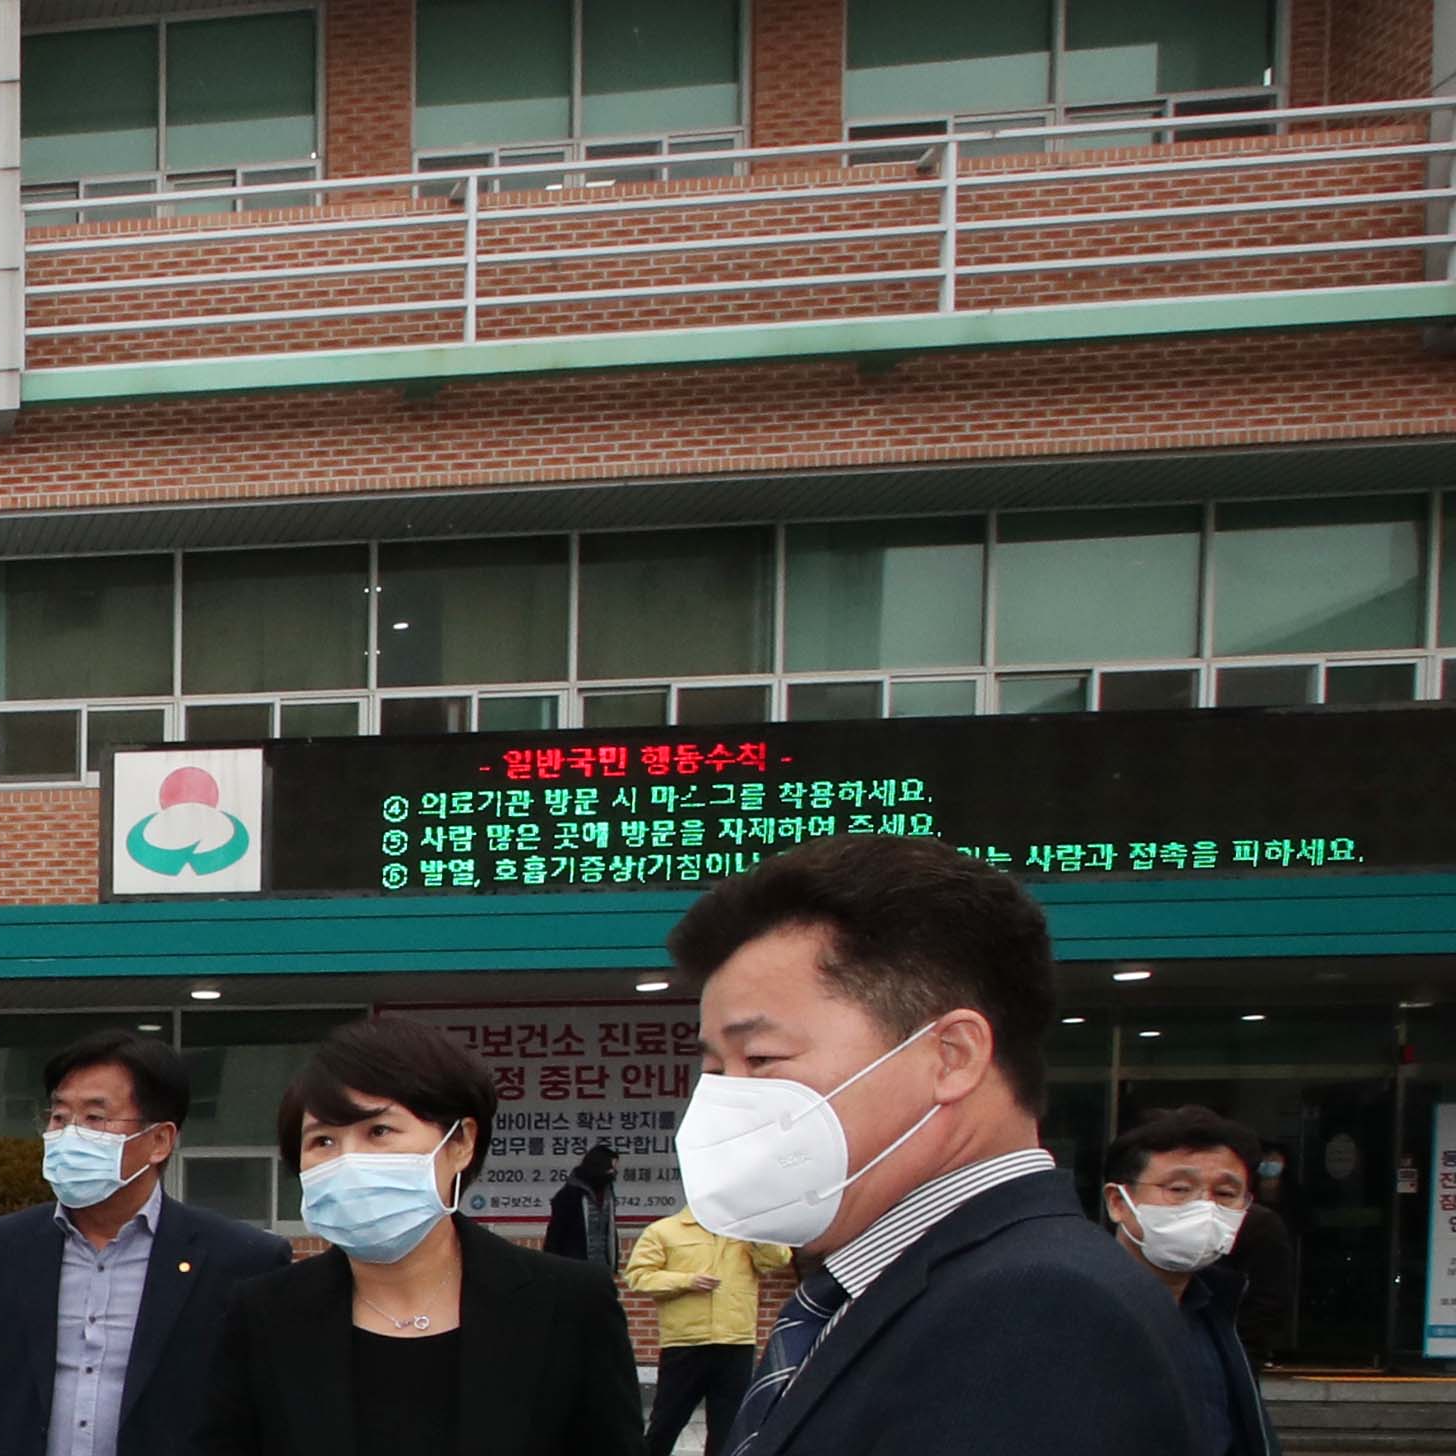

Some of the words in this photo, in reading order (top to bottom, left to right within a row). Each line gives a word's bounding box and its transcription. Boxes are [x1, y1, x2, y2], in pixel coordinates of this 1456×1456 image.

[502, 747, 629, 780] 일반국민
[640, 741, 769, 776] 행동수칙
[418, 789, 535, 820] 의료기관
[544, 787, 600, 817] 방문
[612, 786, 637, 814] 시
[419, 824, 478, 853] 사람
[486, 822, 542, 851] 많은
[553, 820, 610, 850] 곳에
[620, 818, 706, 849] 방문을
[718, 814, 836, 845] 자제하여
[419, 858, 481, 889] 발열,
[1025, 843, 1119, 873] 사람과
[1128, 841, 1220, 871] 접촉을
[1231, 837, 1365, 868] 피하세요.
[434, 1023, 586, 1058] 구보건소
[489, 1065, 526, 1100] 정
[538, 1064, 610, 1100] 중단
[621, 1064, 690, 1099] 안내
[551, 1135, 588, 1156] 잠정
